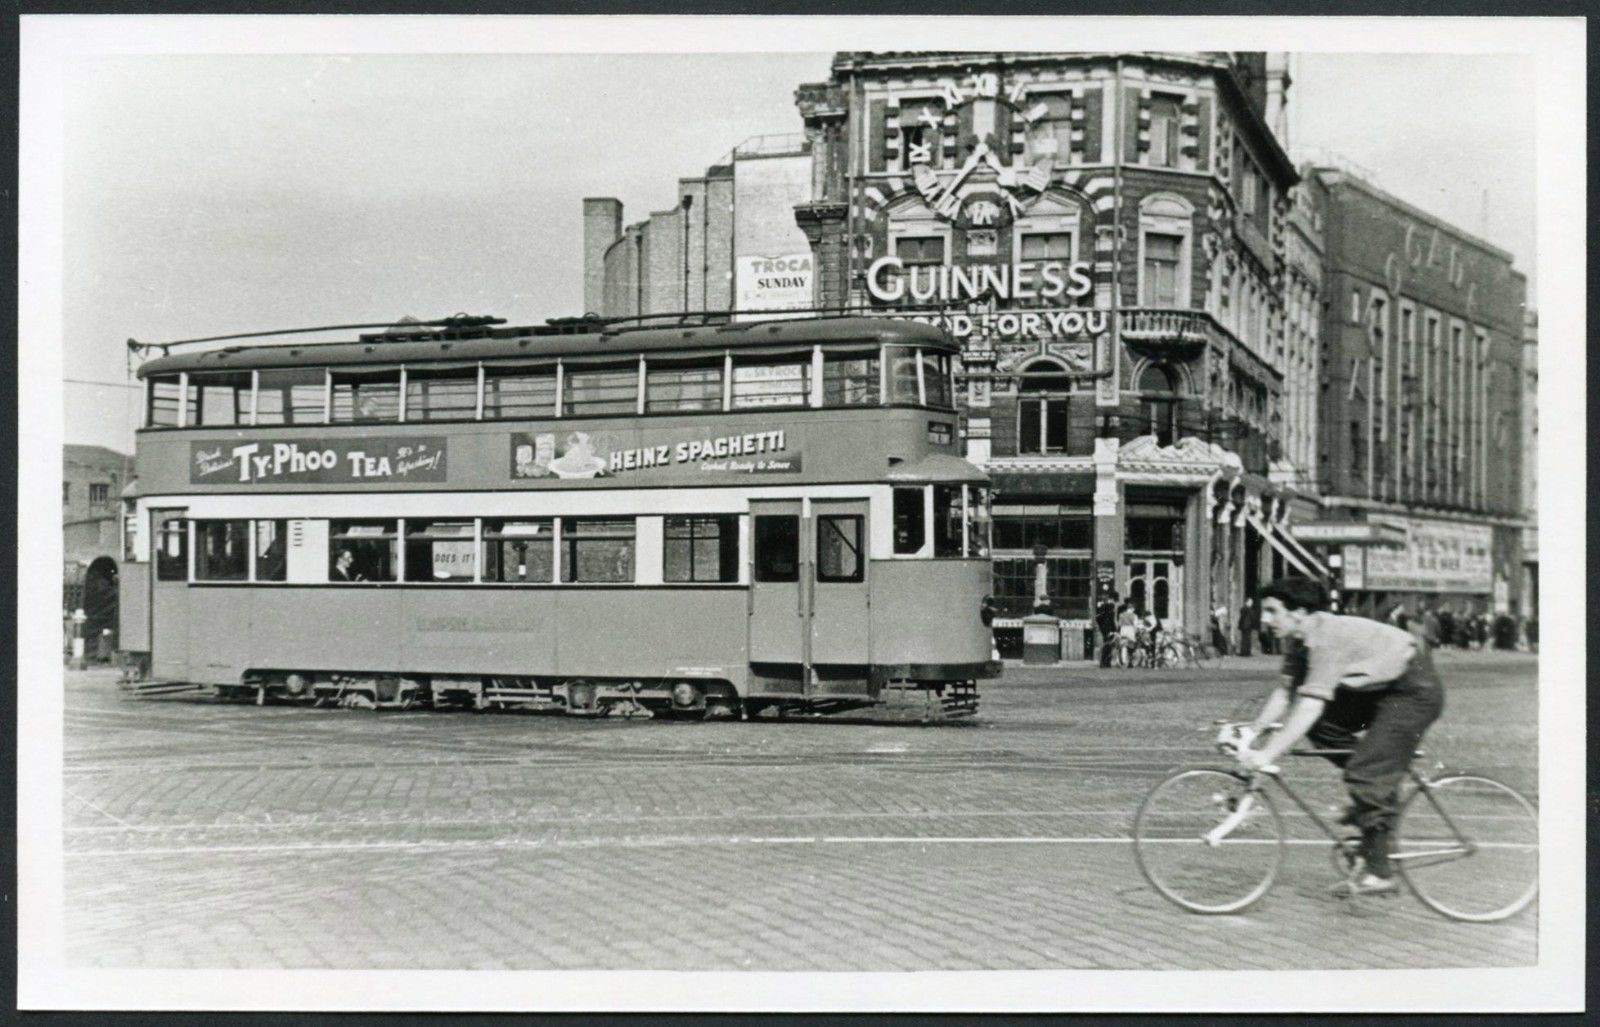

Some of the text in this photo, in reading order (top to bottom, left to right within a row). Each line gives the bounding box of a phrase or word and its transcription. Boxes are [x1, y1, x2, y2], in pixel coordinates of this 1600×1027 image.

[751, 258, 812, 274] TROCA
[867, 256, 1093, 301] GUINNESS
[757, 276, 808, 290] SUNDAY
[981, 313, 1042, 336] FOR
[1045, 311, 1107, 335] YOU
[609, 430, 786, 471] HEINZ SPAGHETTI
[346, 451, 393, 477] TEA
[434, 553, 457, 564] DOES
